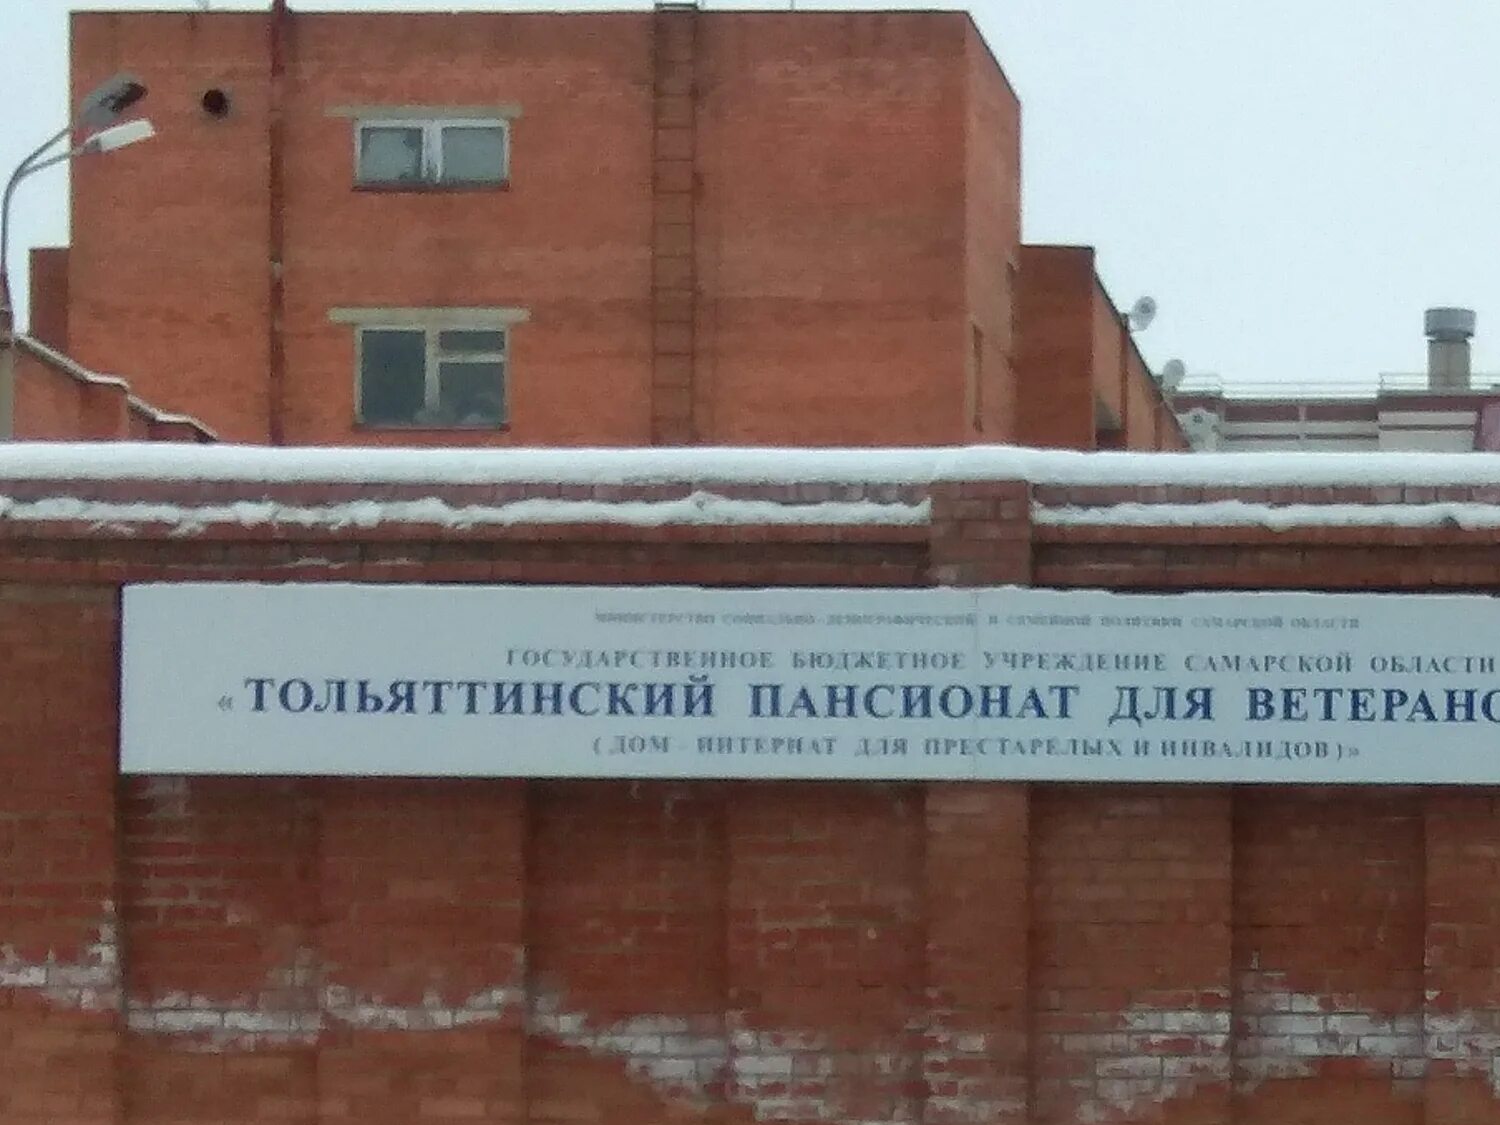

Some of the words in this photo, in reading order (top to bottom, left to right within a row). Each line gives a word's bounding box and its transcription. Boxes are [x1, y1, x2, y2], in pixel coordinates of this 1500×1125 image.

[505, 647, 775, 670] ГОСУДАРСТВЕННОЕ
[790, 649, 966, 672] БЮДЖЕТНОЕ
[982, 651, 1168, 673] УЧРЕЖДЕНИЕ
[1183, 651, 1352, 674] САМАРСКОЙ
[1370, 655, 1497, 675] ОБЛАСТИ
[748, 682, 1081, 720] ПАНСИОНАТ
[1107, 686, 1216, 728] ДЛЯ
[696, 735, 838, 757] ИНТЕРНАТ
[854, 736, 908, 758] ДЛЯ
[924, 736, 1123, 759] ПРЕСТАРЕЛЫХ
[1132, 738, 1151, 758] И
